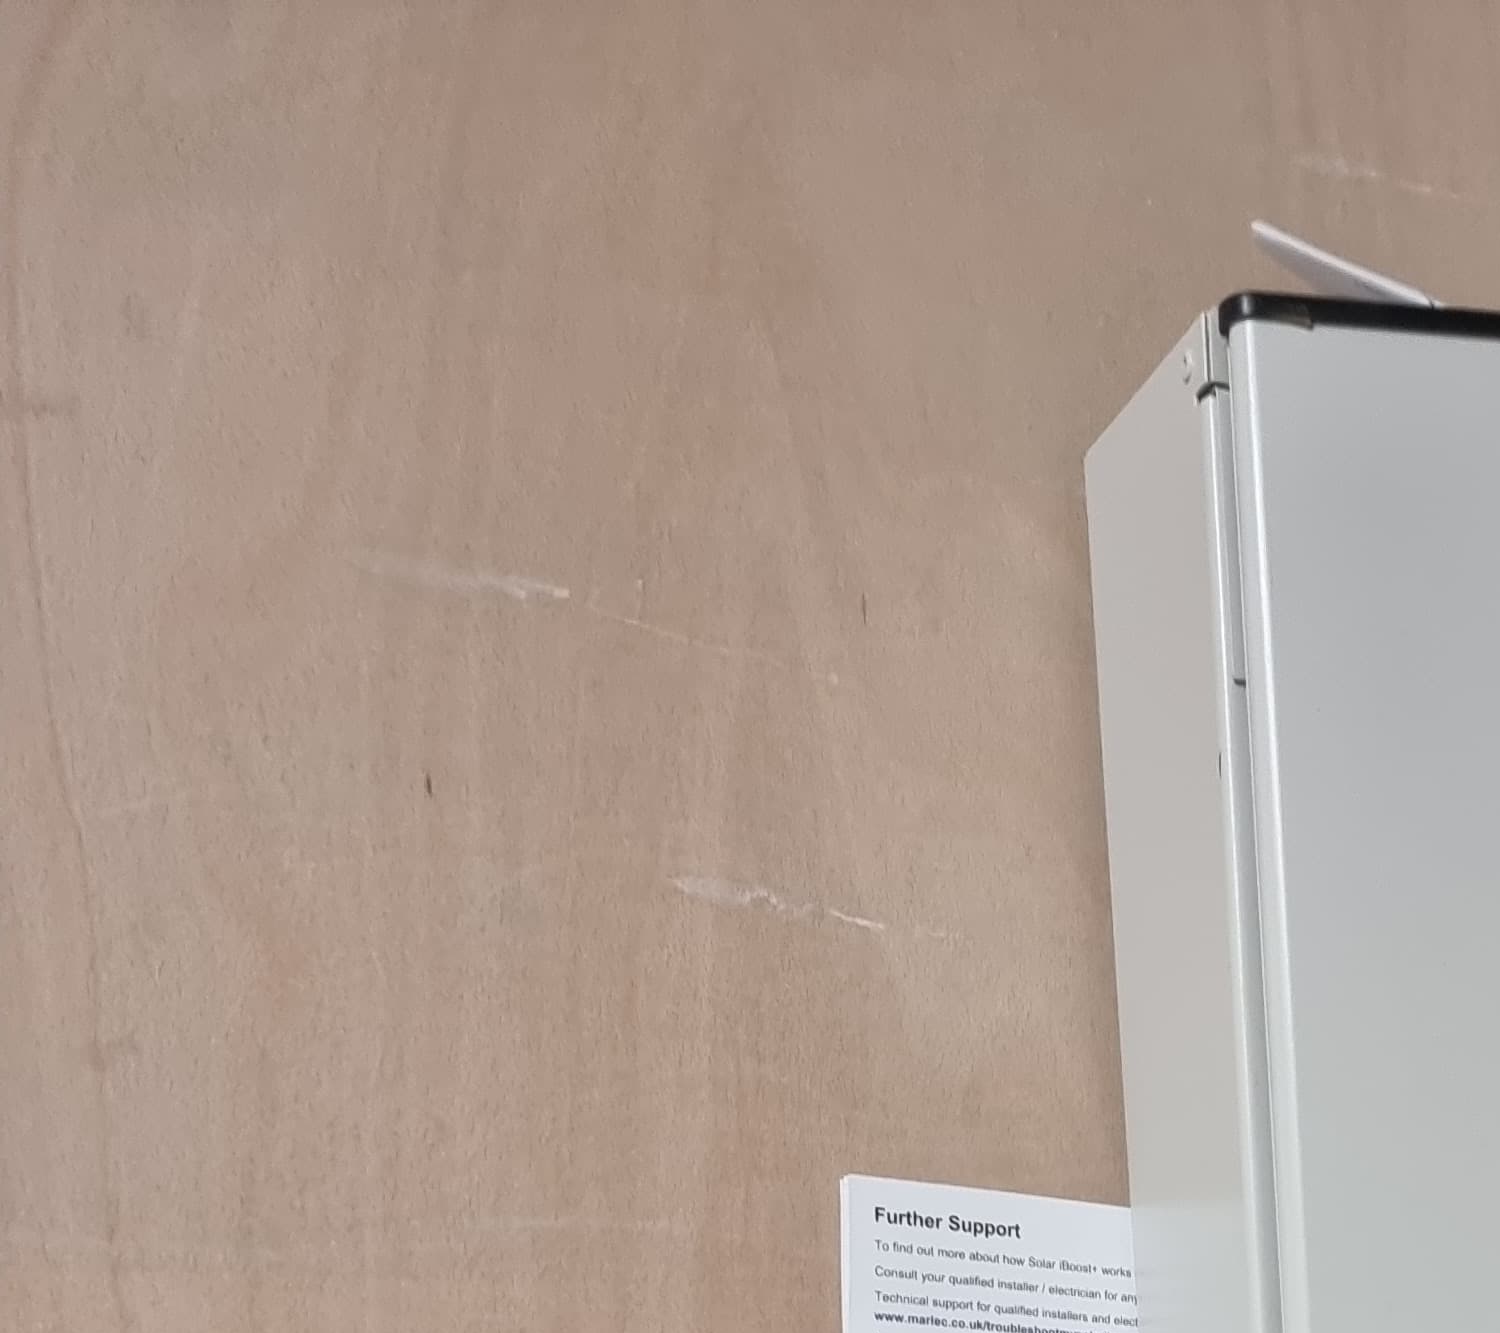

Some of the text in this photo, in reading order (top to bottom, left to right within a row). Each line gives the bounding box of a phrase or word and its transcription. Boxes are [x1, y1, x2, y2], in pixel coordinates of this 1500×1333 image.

[874, 1206, 1020, 1239] Further Support
[874, 1238, 889, 1251] To
[892, 1241, 913, 1254] find
[916, 1245, 934, 1256] out
[937, 1248, 965, 1259] more
[968, 1250, 999, 1264] about
[1002, 1254, 1025, 1266] how
[1028, 1255, 1055, 1269] Solar
[1101, 1266, 1131, 1278] works
